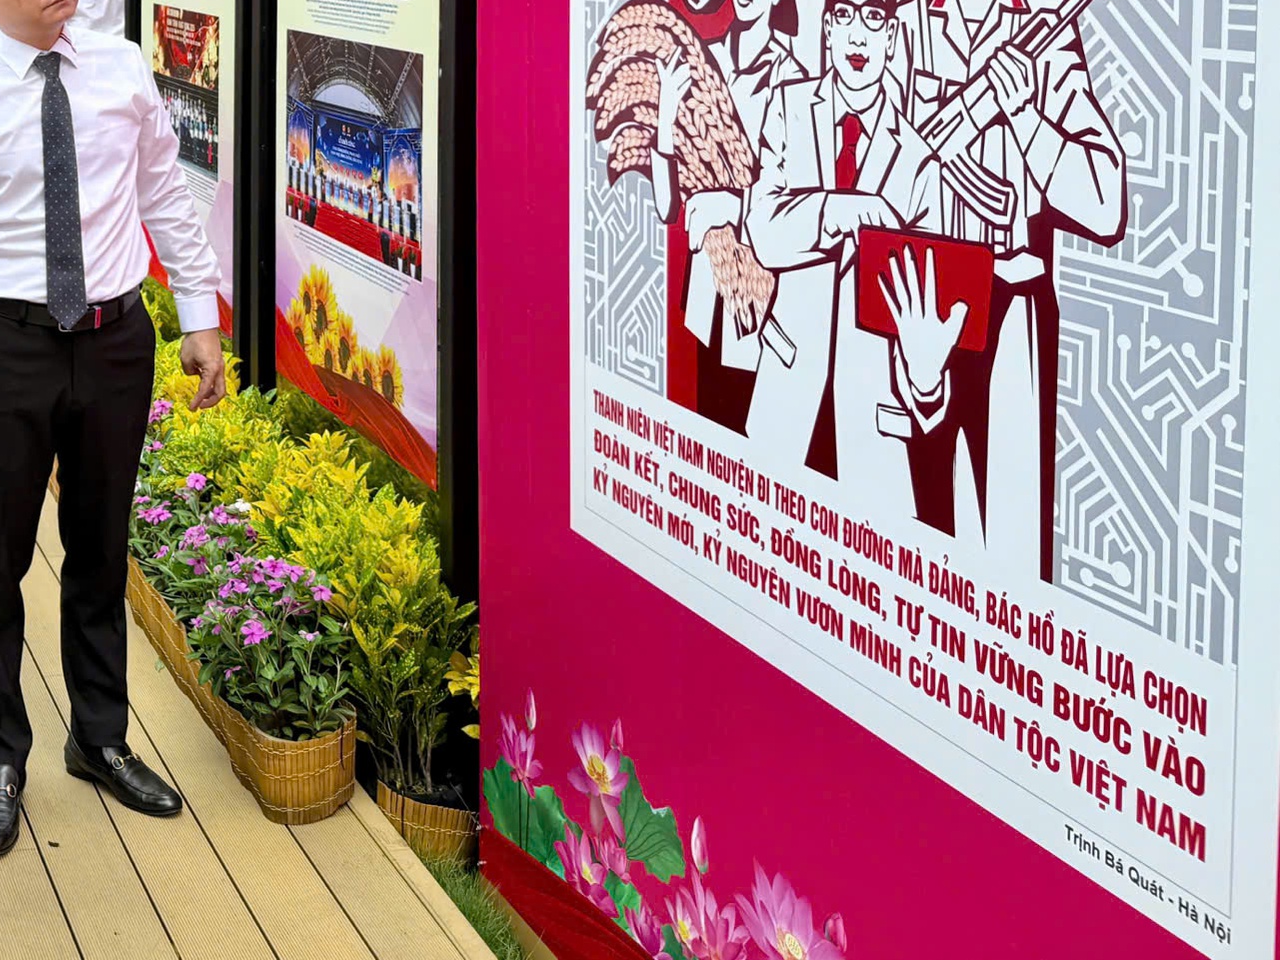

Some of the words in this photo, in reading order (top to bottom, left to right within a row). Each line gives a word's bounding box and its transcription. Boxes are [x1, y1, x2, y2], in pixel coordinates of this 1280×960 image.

[593, 389, 624, 427] THANH
[627, 407, 650, 441] NIÊN
[653, 421, 675, 456] VIỆT
[678, 433, 704, 470] NAM
[707, 448, 754, 497] NGUYỆN
[757, 472, 770, 506] ĐI
[774, 481, 806, 524] THEO
[810, 501, 838, 541] CON
[843, 516, 893, 571] ĐƯỜNG
[899, 547, 924, 587] MÀ
[928, 554, 980, 621] ĐẢNG,
[985, 591, 1021, 639] BÁC
[1028, 610, 1055, 656] HỒ
[1060, 628, 1089, 675] ĐÃ
[1095, 645, 1136, 700] LỰA
[1143, 670, 1207, 737] CHỌN
[593, 463, 609, 496] KỶ
[612, 478, 663, 530] NGUYÊN
[667, 513, 698, 555] MỚI,
[703, 528, 722, 566] KỶ
[726, 546, 790, 609] NGUYÊN
[796, 587, 843, 642] VƯƠN
[850, 619, 901, 678] MÌNH
[908, 652, 951, 708] CỦA
[958, 684, 1005, 741] DÂN
[1013, 717, 1060, 773] TỘC
[1070, 748, 1127, 813] VIỆT
[1136, 787, 1206, 862] NAM
[594, 428, 630, 470] ĐOÀN
[634, 451, 664, 493] KẾT,
[668, 471, 721, 523] CHUNG
[726, 503, 765, 551] SỨC,
[771, 527, 821, 580] ĐỒNG
[827, 558, 887, 622] LÒNG,
[894, 595, 924, 642] TỰ
[928, 613, 965, 664] TIN
[974, 638, 1043, 708] VỮNG
[1053, 682, 1132, 755] BƯỚC
[1143, 730, 1206, 797] VÀO
[1065, 824, 1100, 860] Trịnh
[1105, 851, 1123, 875] Bá
[1128, 866, 1164, 901] Quát
[1178, 897, 1199, 924] Hà
[1204, 913, 1231, 944] Nội
